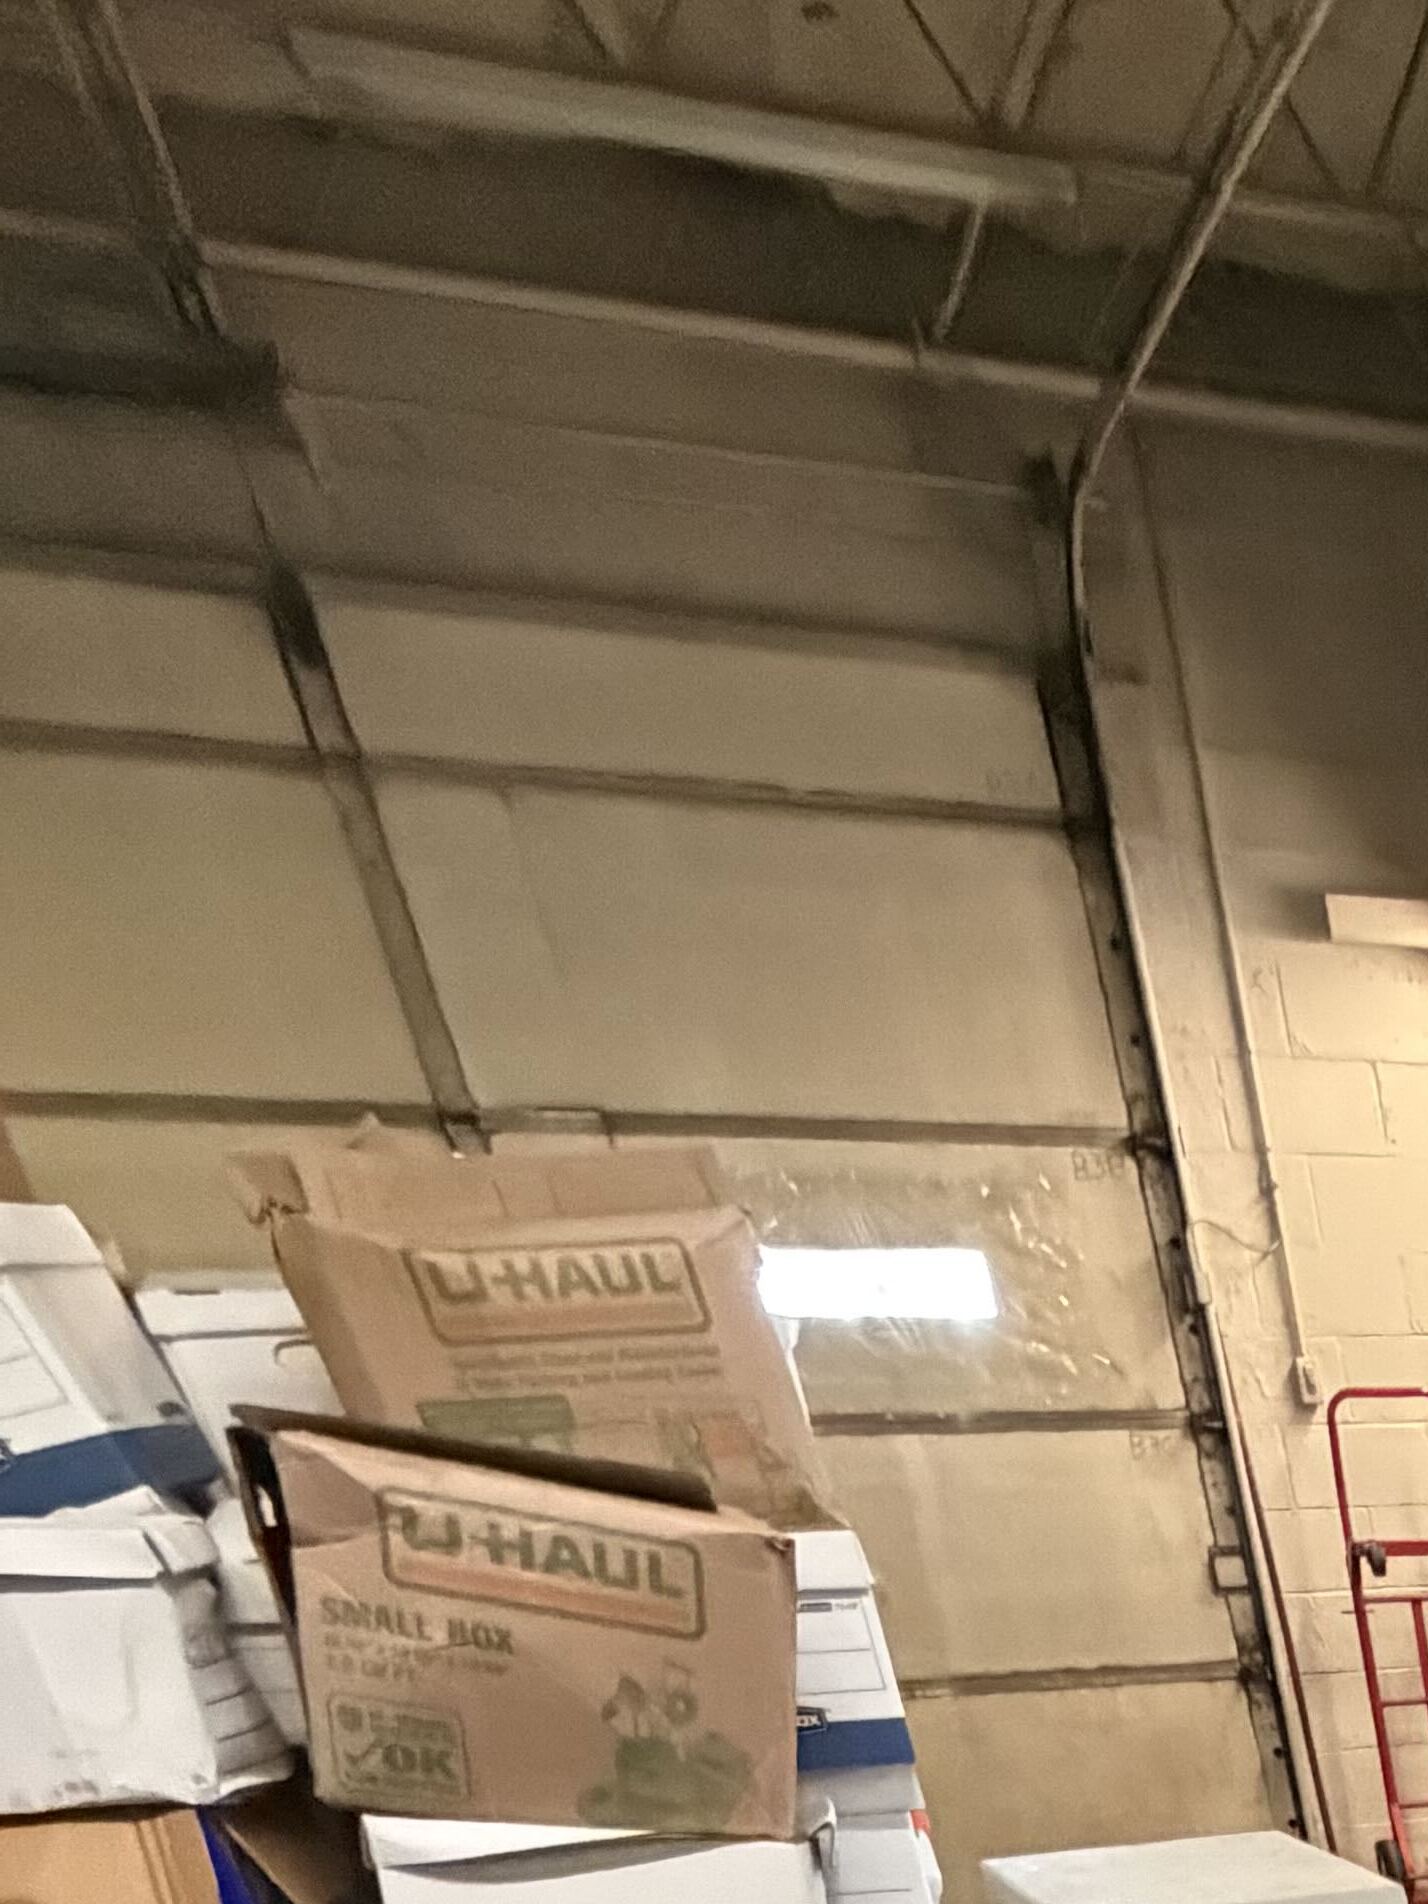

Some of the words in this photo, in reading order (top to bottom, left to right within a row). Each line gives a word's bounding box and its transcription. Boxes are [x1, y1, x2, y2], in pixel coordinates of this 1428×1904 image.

[424, 1252, 681, 1303] U-HAUL
[396, 1503, 685, 1599] U-HAUL
[320, 1597, 432, 1641] SMALL
[448, 1618, 514, 1654] BOX
[797, 1714, 821, 1728] OX
[382, 1743, 454, 1779] OK
